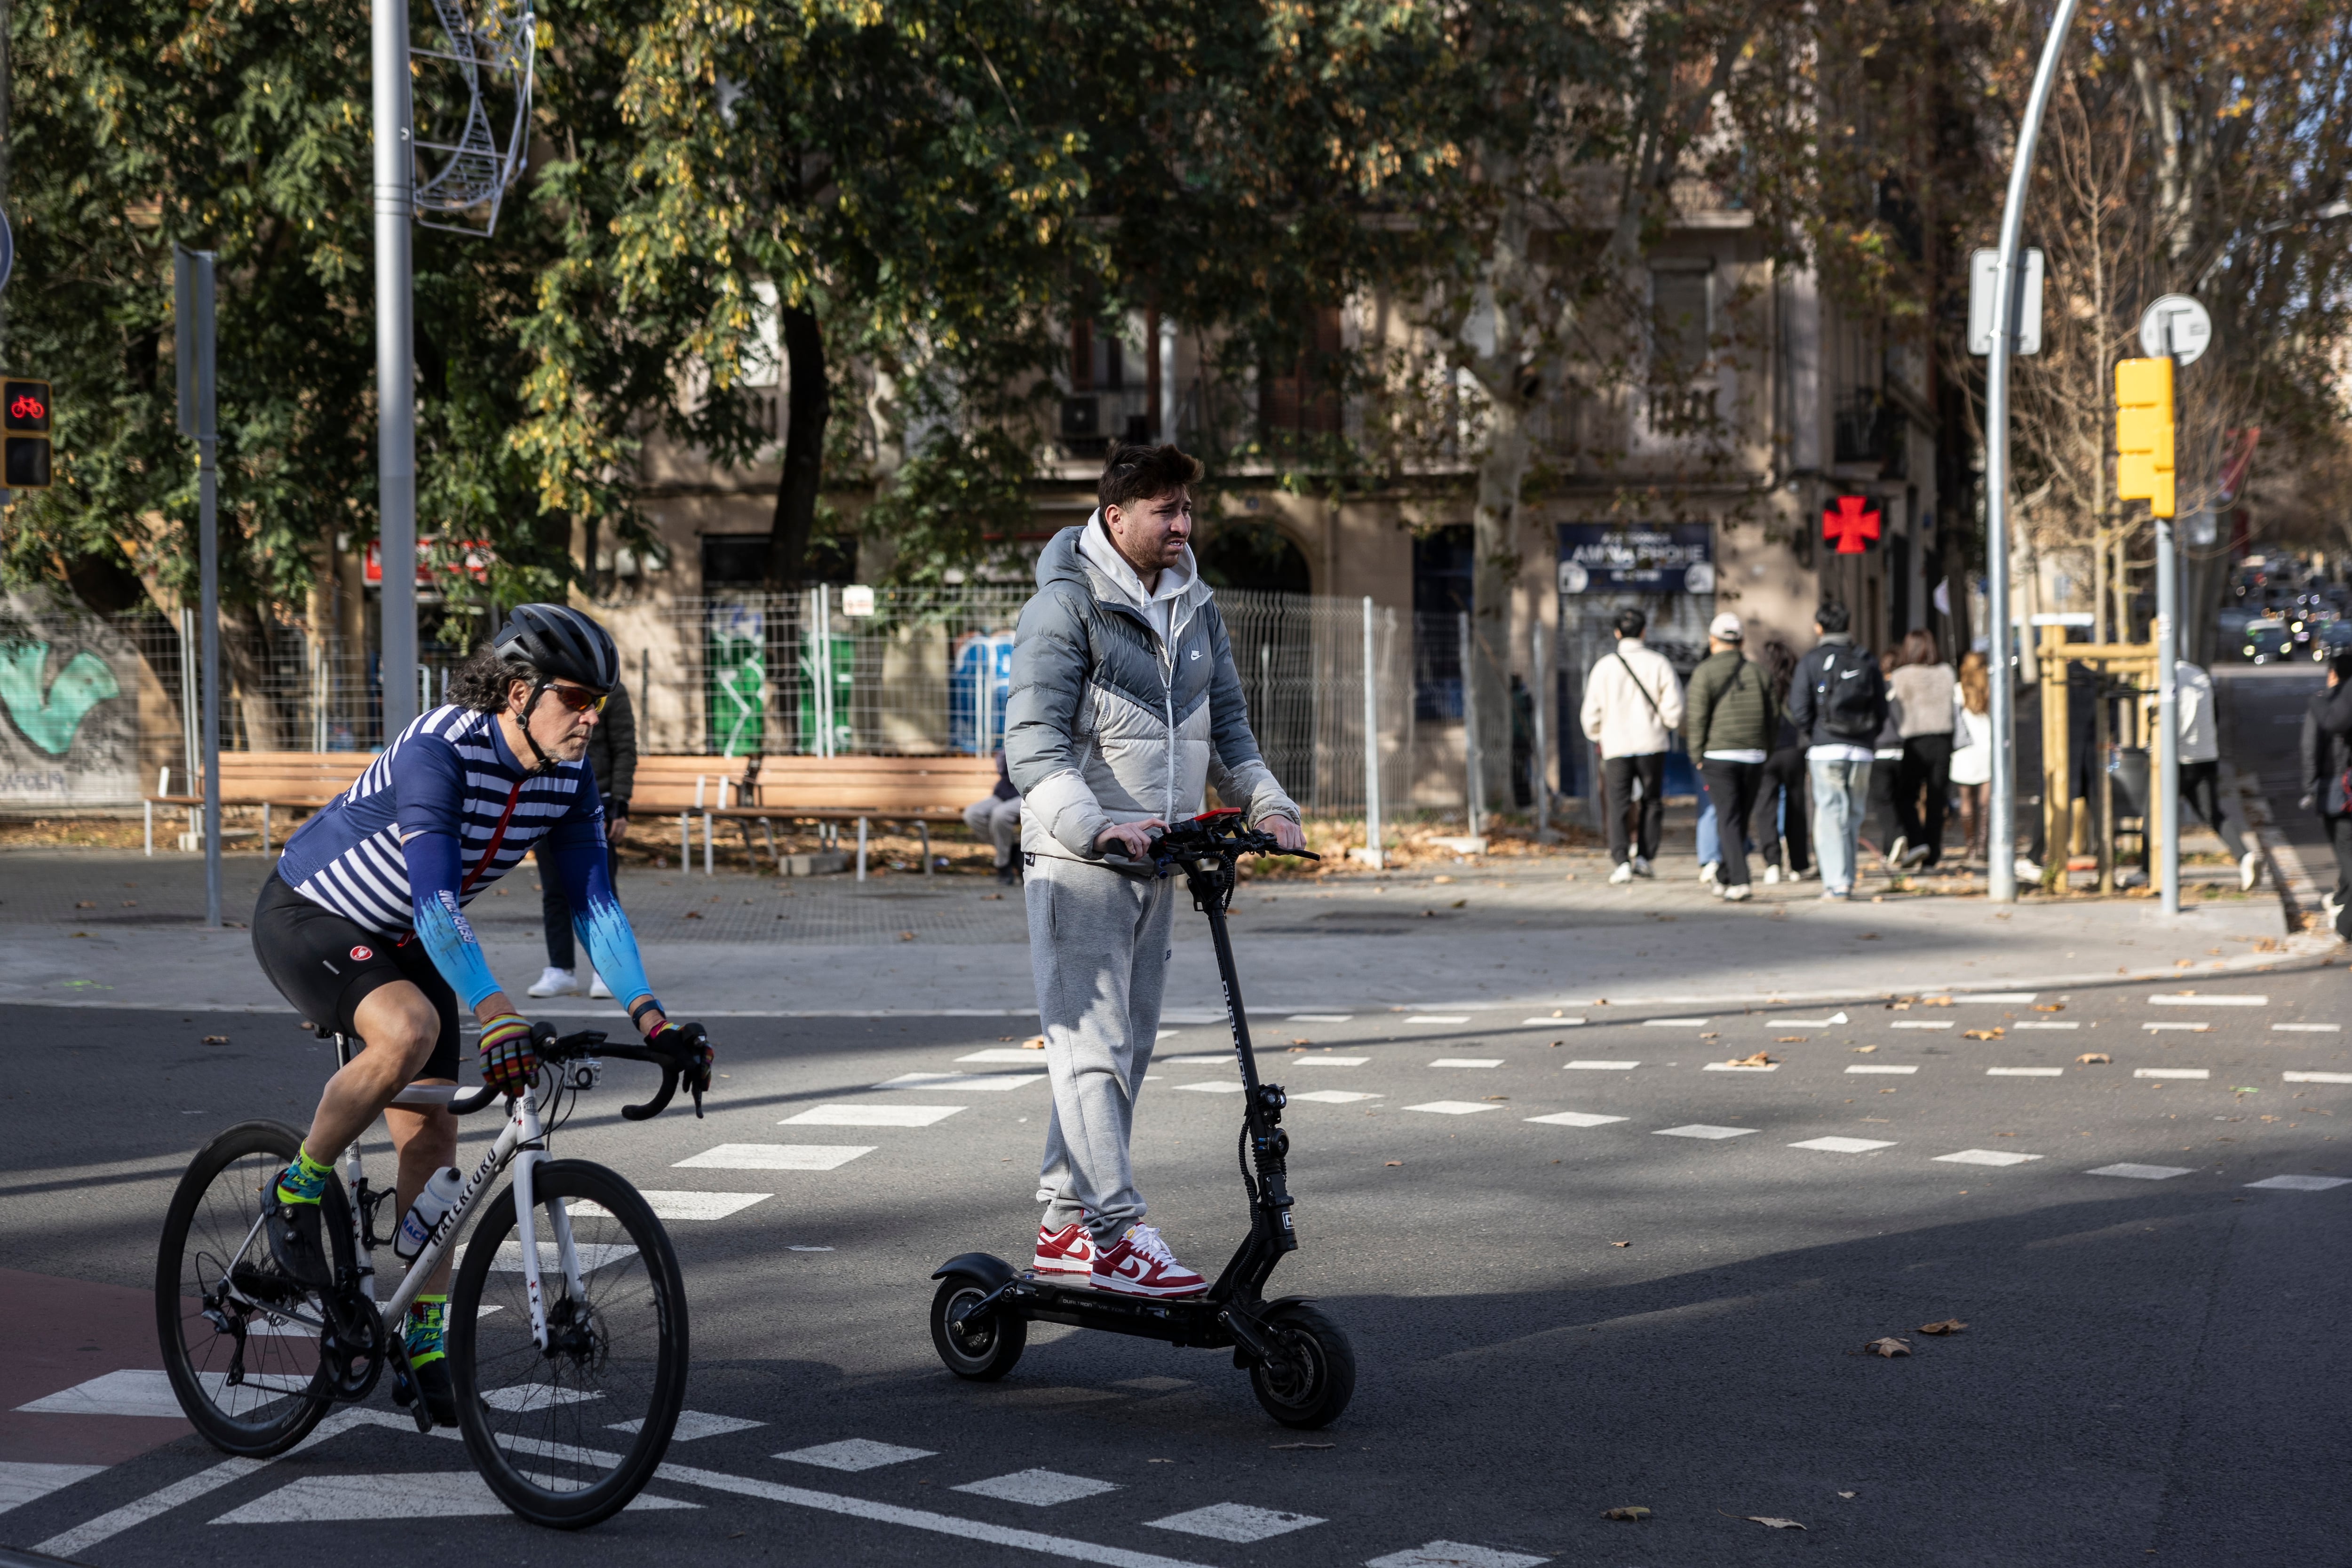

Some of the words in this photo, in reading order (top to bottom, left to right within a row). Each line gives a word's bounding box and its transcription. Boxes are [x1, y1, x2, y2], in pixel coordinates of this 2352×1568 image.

[431, 1148, 497, 1248] WATERFORD
[1062, 1298, 1093, 1308] DUALTRON
[1098, 1304, 1126, 1313] VICTOR
